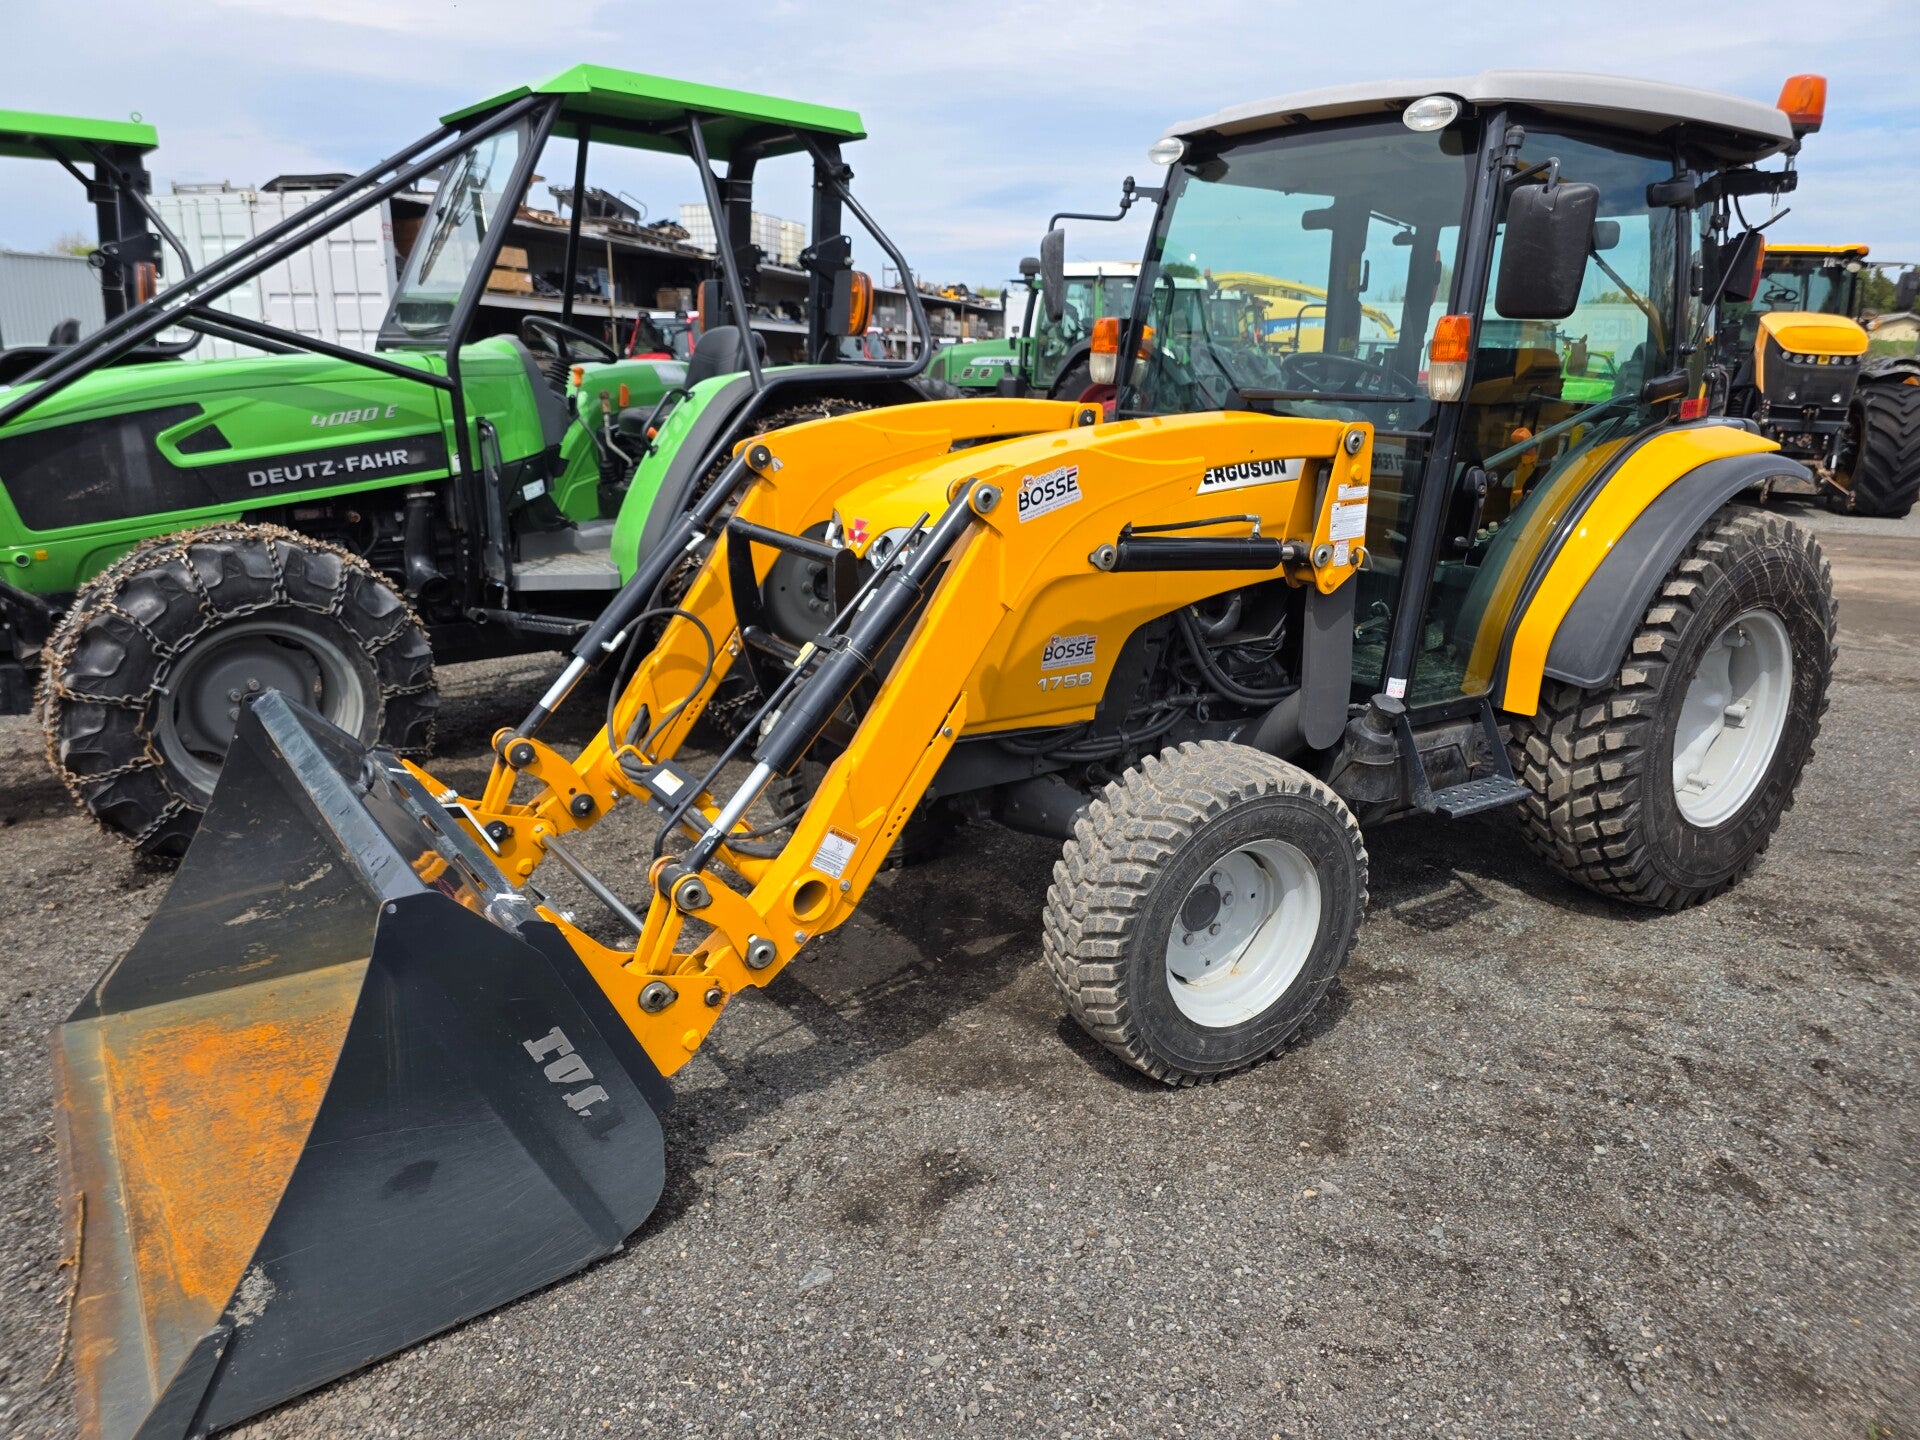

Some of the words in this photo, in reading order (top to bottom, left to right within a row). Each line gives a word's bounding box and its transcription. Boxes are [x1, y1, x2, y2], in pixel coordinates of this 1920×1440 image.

[311, 407, 379, 427] 4080
[384, 404, 399, 418] E
[1035, 467, 1066, 485] GROUPE
[1019, 471, 1078, 512] BOSSE
[1042, 640, 1096, 661] BOSSE
[1037, 671, 1093, 691] 1758
